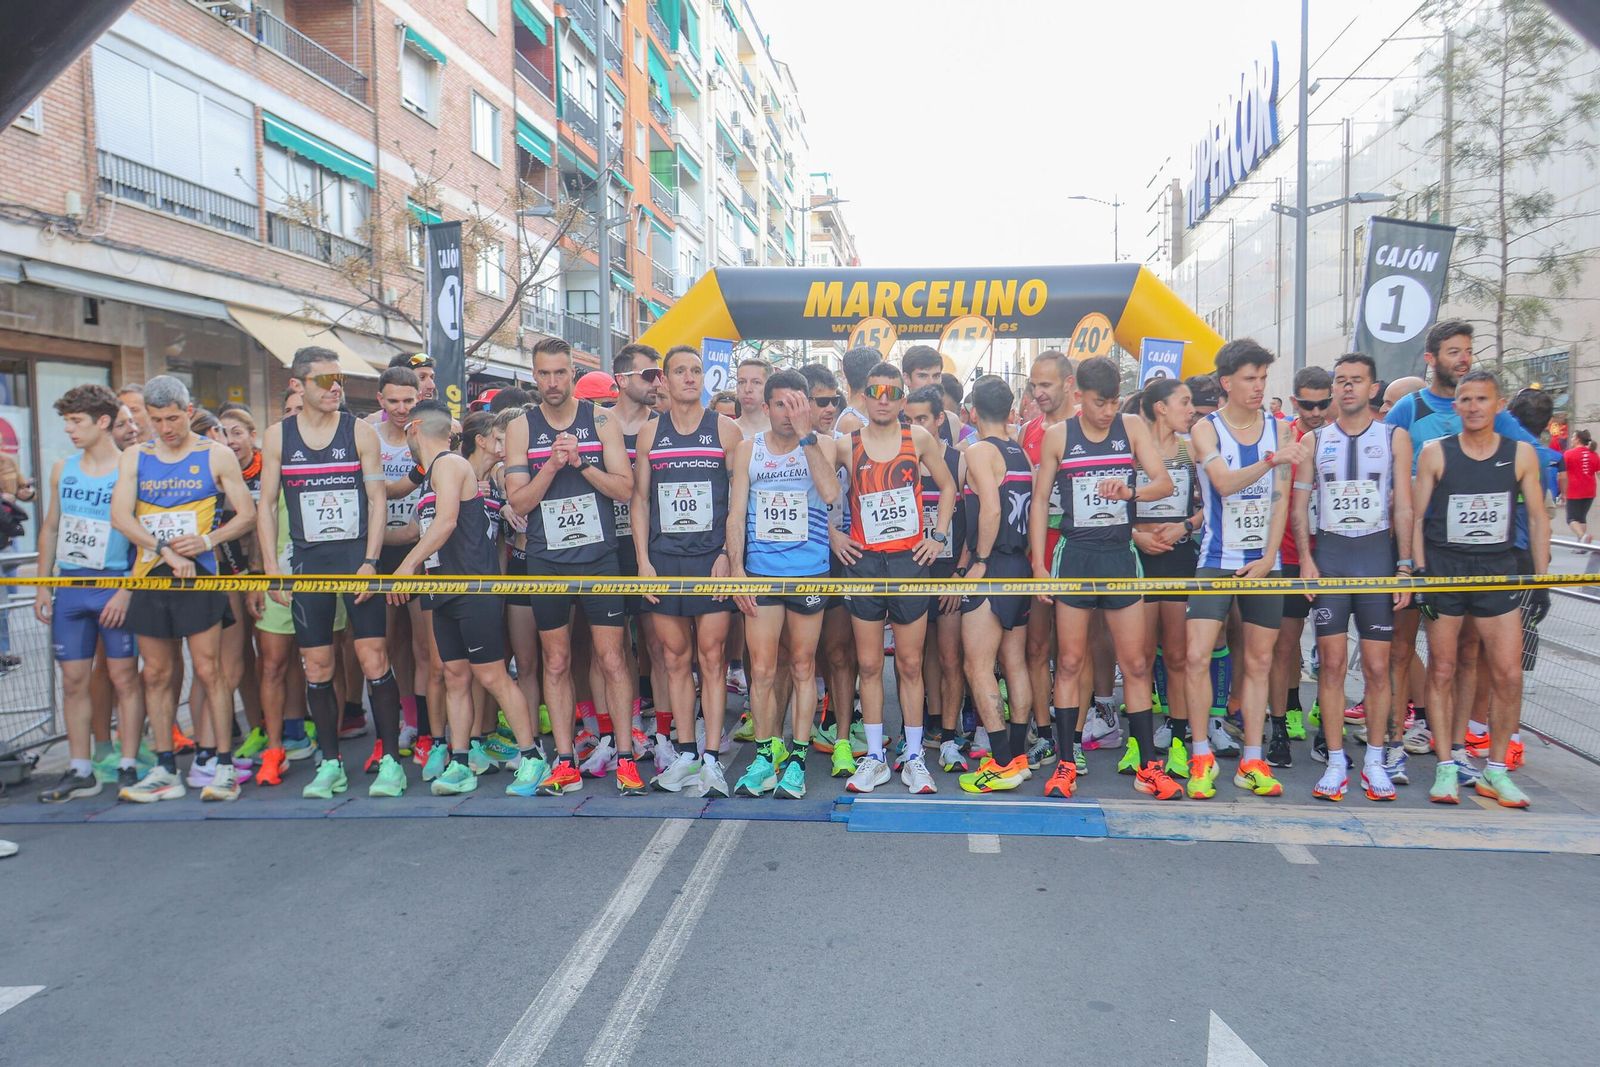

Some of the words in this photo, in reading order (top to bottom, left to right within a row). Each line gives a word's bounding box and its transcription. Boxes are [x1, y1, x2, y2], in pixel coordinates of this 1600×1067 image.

[1186, 40, 1280, 230] HIPERCOR
[1375, 244, 1440, 272] CAJÓN
[803, 278, 1049, 318] MARCELINO
[448, 284, 458, 330] 1
[1379, 284, 1406, 334] 1
[853, 326, 890, 349] 45'
[1074, 327, 1110, 353] 40'
[1148, 350, 1178, 364] CAJÓN
[711, 369, 722, 393] 2
[756, 468, 808, 481] MARACENA
[140, 476, 203, 493] agustinos
[62, 486, 112, 507] nerja
[1333, 497, 1370, 511] 2318
[316, 507, 344, 521] 731
[671, 499, 697, 512] 108
[763, 507, 798, 521] 1915
[871, 505, 907, 523] 1255
[557, 513, 585, 529] 242
[1234, 515, 1265, 529] 1832
[1458, 510, 1498, 524] 2248
[65, 530, 96, 548] 2948
[194, 579, 271, 591] MARCELINO
[292, 580, 370, 592] MARCELINO
[391, 582, 470, 593] MARCELINO
[491, 583, 569, 593] MARCELINO
[591, 583, 671, 593] MARCELINO
[693, 583, 772, 593] MARCELINO
[795, 583, 875, 593] MARCELINO
[898, 583, 978, 593] MARCELINO
[1002, 583, 1082, 592] MARCELINO
[1106, 581, 1187, 591] MARCELINO
